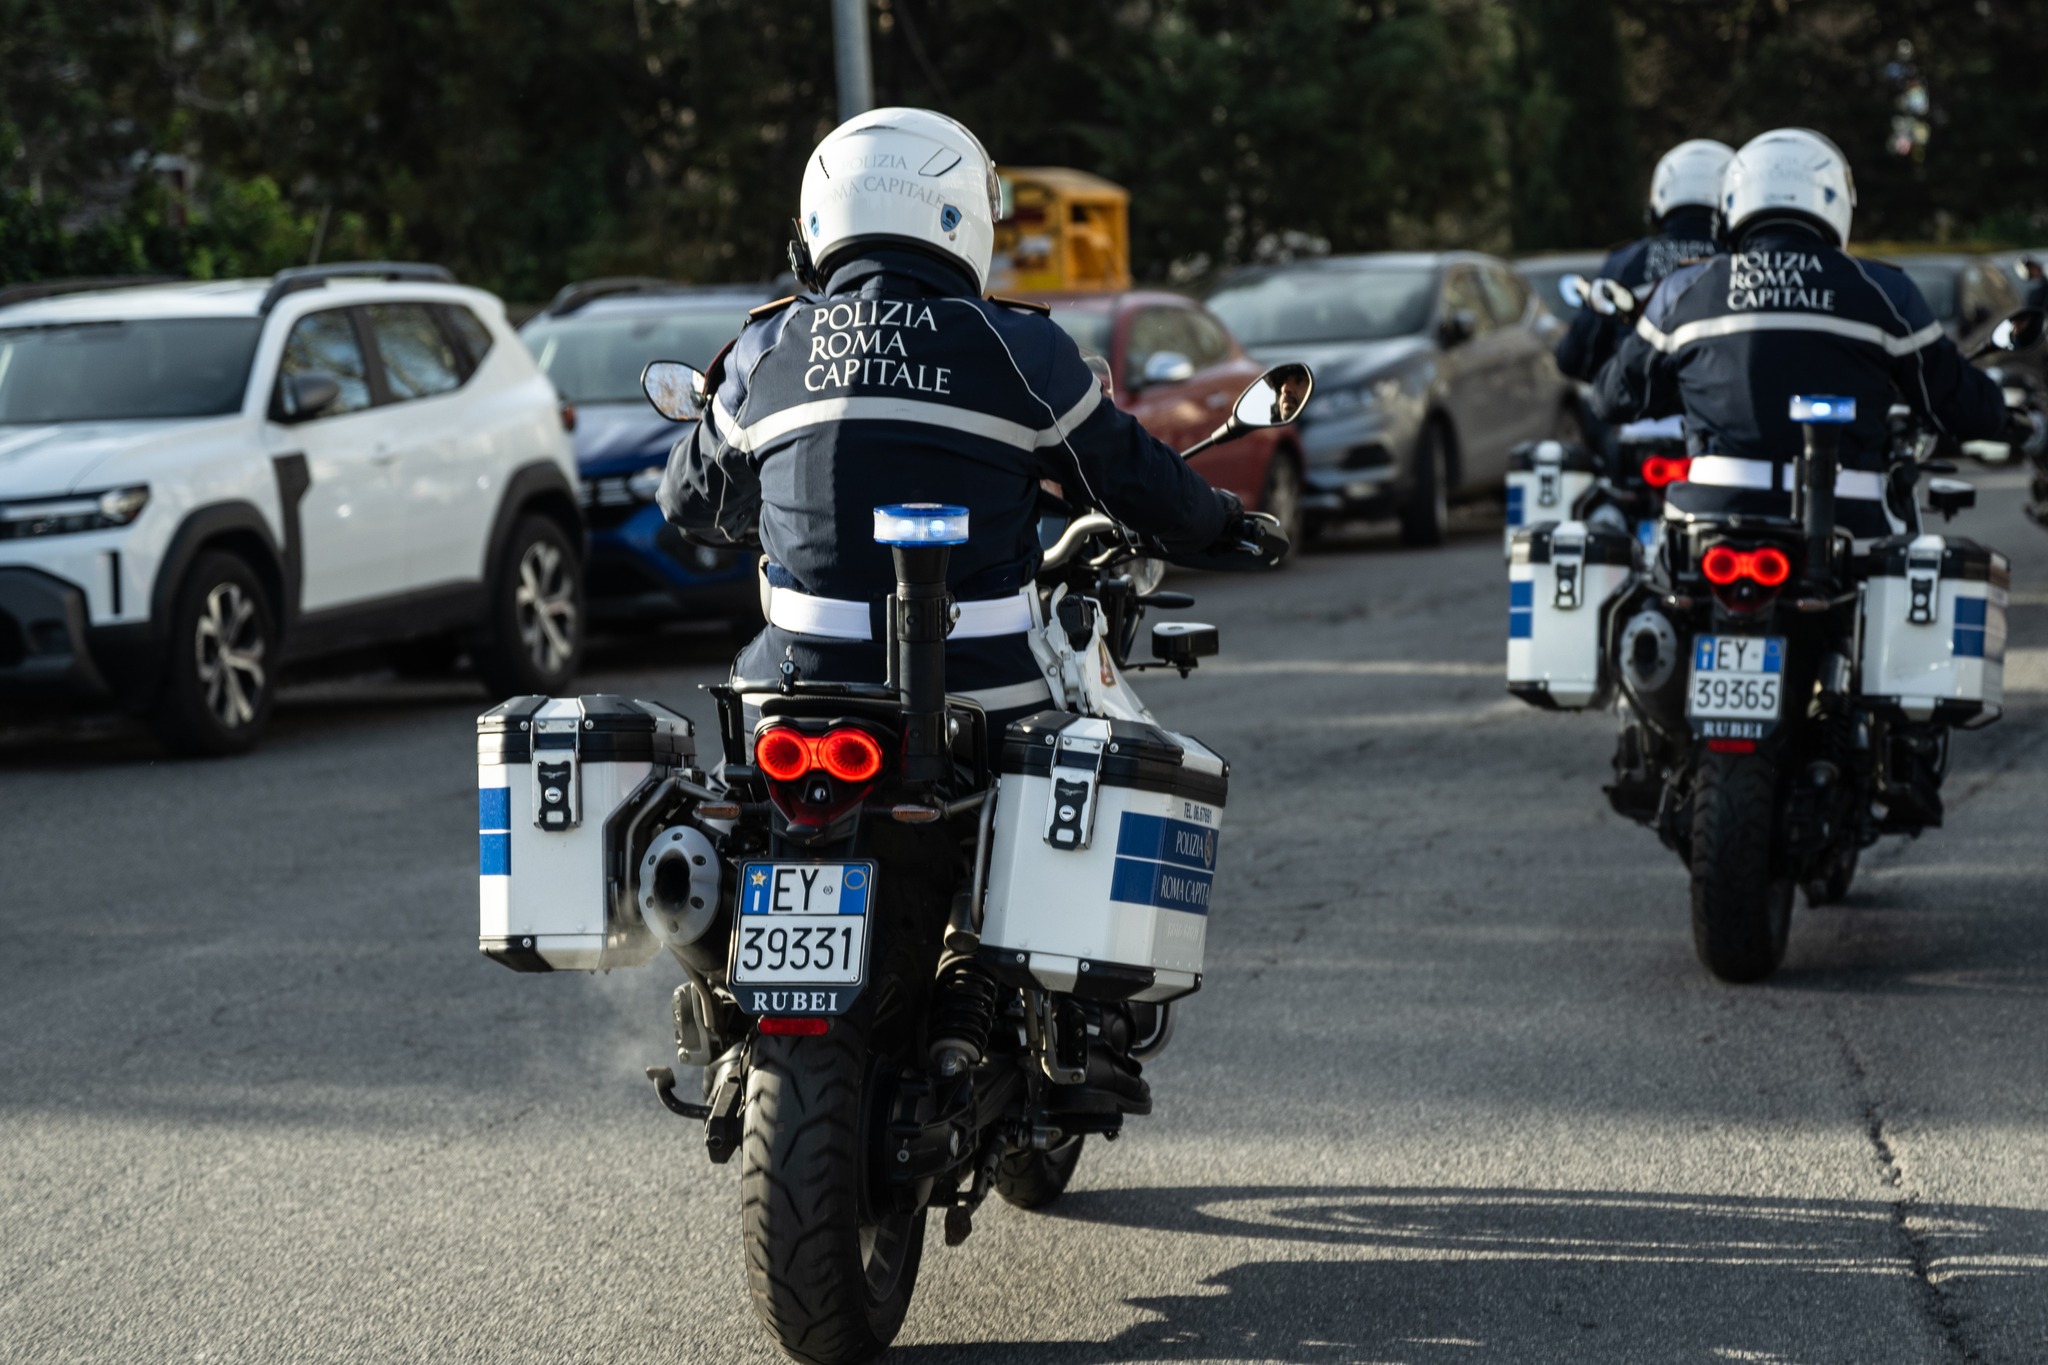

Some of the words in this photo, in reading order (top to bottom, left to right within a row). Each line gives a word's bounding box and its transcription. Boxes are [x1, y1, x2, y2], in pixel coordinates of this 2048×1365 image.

[863, 176, 946, 211] CAPITALE
[1730, 251, 1823, 273] POLIZIA
[1729, 268, 1804, 290] ROMA
[1727, 287, 1835, 311] CAPITALE
[810, 300, 938, 333] POLIZIA
[808, 329, 908, 363] ROMA
[804, 358, 951, 395] CAPITALE
[1717, 639, 1748, 670] EY
[1697, 678, 1776, 710] 39365
[1703, 721, 1763, 739] RUBEI
[1175, 830, 1204, 859] POLIZIA
[773, 869, 819, 911] EY
[1160, 875, 1184, 901] ROMA
[742, 927, 852, 970] 39331
[752, 992, 838, 1012] RUBEI
